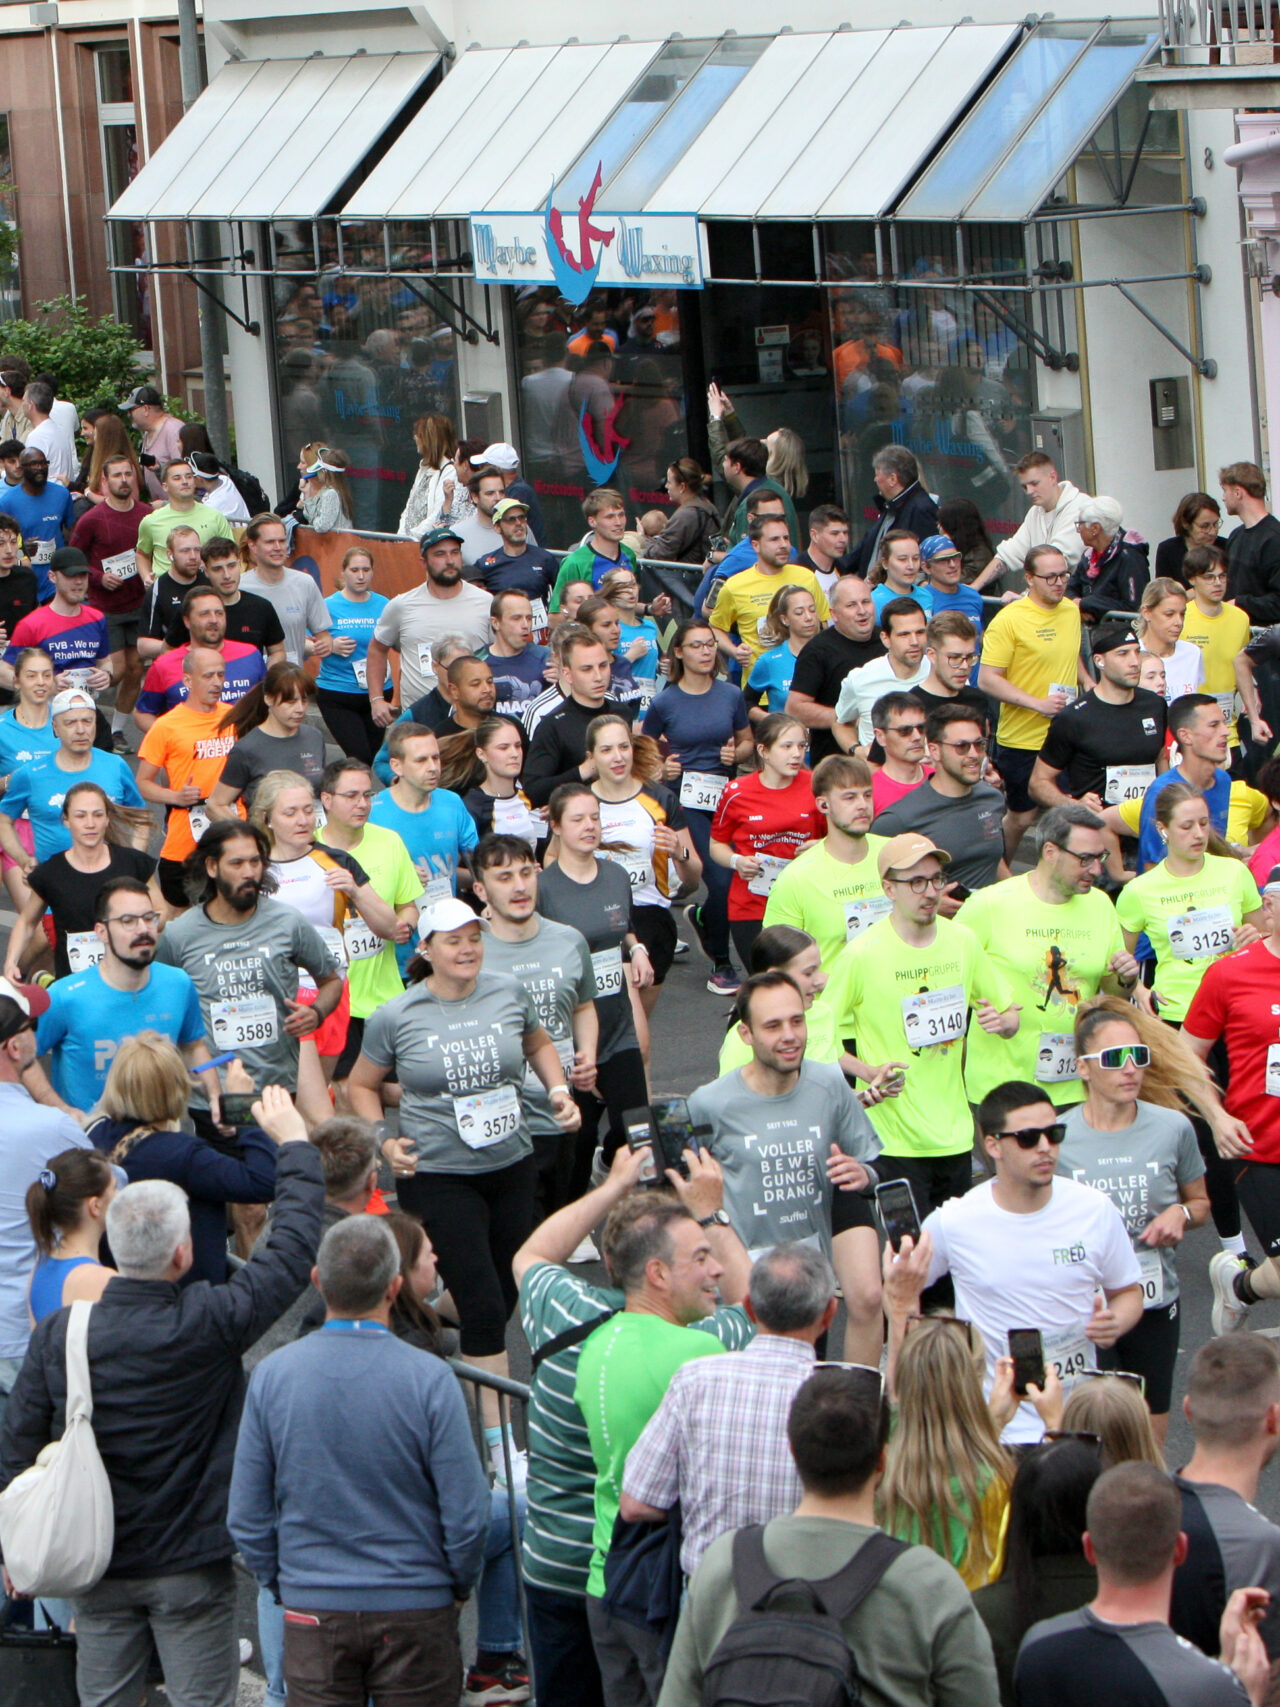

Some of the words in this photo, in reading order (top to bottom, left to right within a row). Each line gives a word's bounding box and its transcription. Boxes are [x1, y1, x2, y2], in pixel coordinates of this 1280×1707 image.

[473, 223, 537, 275] Maybe
[618, 216, 696, 285] Waxing
[49, 642, 68, 652] FVB
[74, 640, 88, 649] We
[54, 650, 97, 661] Rhein/Main
[233, 678, 250, 687] run
[1026, 928, 1092, 940] PHILIPPGRUPPE
[1192, 928, 1231, 951] 3125
[215, 957, 263, 974] VOLLER
[895, 962, 961, 981] PHILIPPGRUPPE
[217, 969, 264, 986] BEWE
[219, 980, 264, 997] GUNGS
[235, 1021, 273, 1043] 3589
[928, 1011, 963, 1037] 3140
[440, 1034, 497, 1055] VOLLER
[443, 1047, 500, 1068] BEWE
[446, 1060, 501, 1081] GUNGS
[483, 1113, 516, 1138] 3573
[758, 1139, 815, 1158] VOLLER
[761, 1154, 816, 1174] BEWE
[762, 1168, 815, 1188] GUNGS
[764, 1182, 815, 1203] DRANG
[1052, 1245, 1087, 1265] FRED
